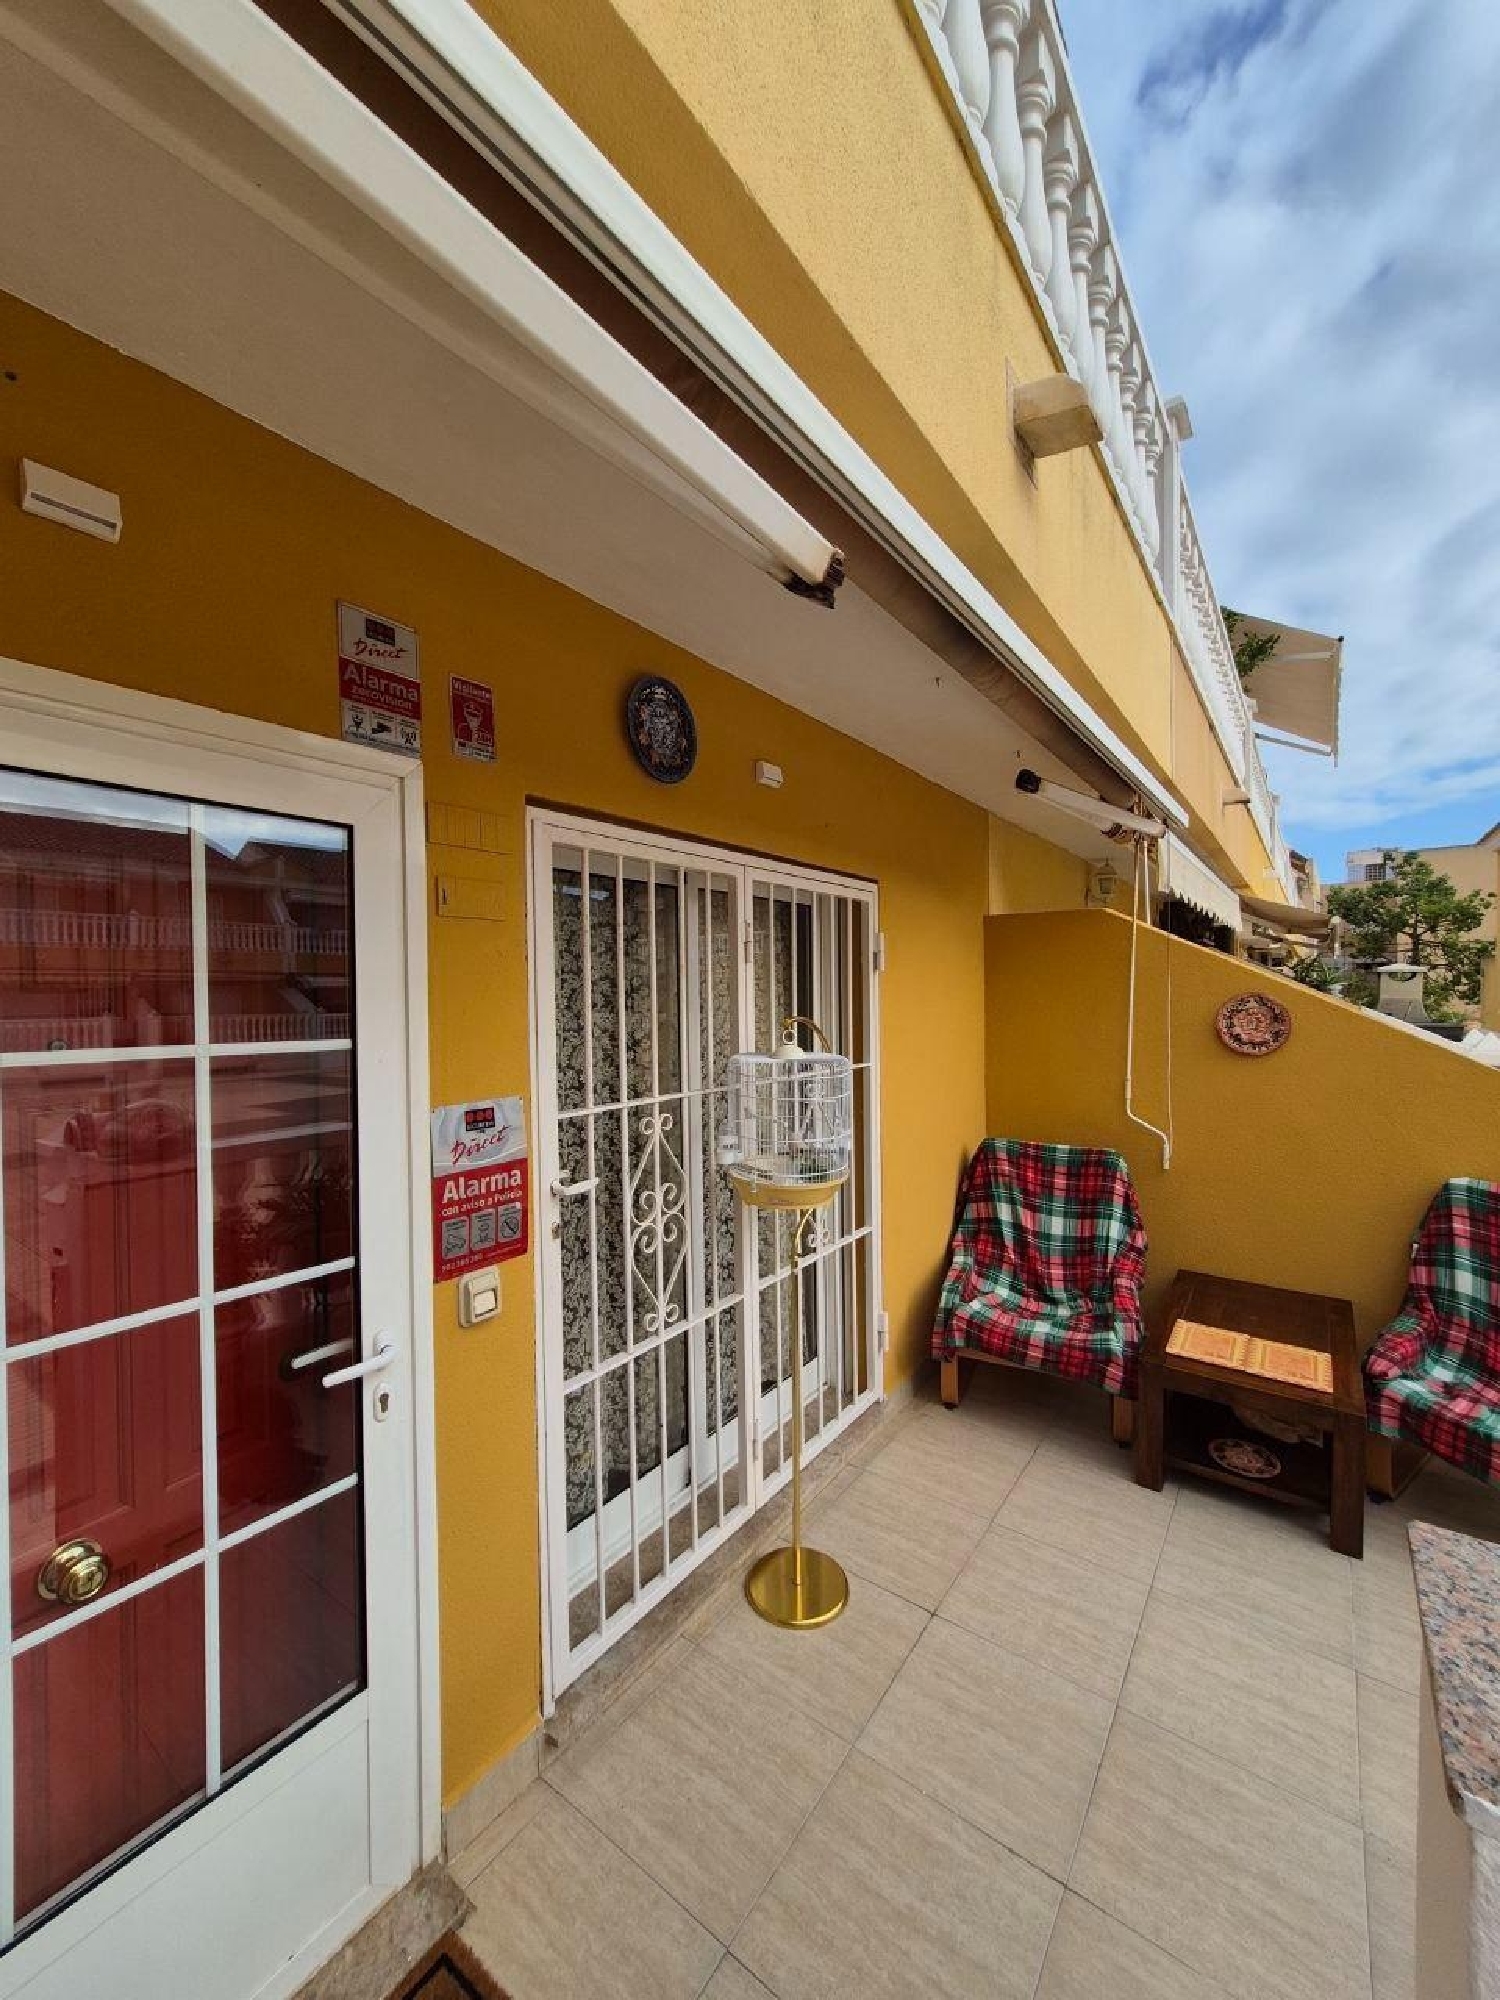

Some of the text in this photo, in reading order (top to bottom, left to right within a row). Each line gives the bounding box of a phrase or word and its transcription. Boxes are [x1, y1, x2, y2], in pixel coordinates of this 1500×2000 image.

[343, 663, 418, 701] Alarma
[450, 1125, 512, 1164] Direct
[442, 1169, 522, 1204] Alarma
[441, 1206, 459, 1218] con
[461, 1198, 485, 1213] aviso
